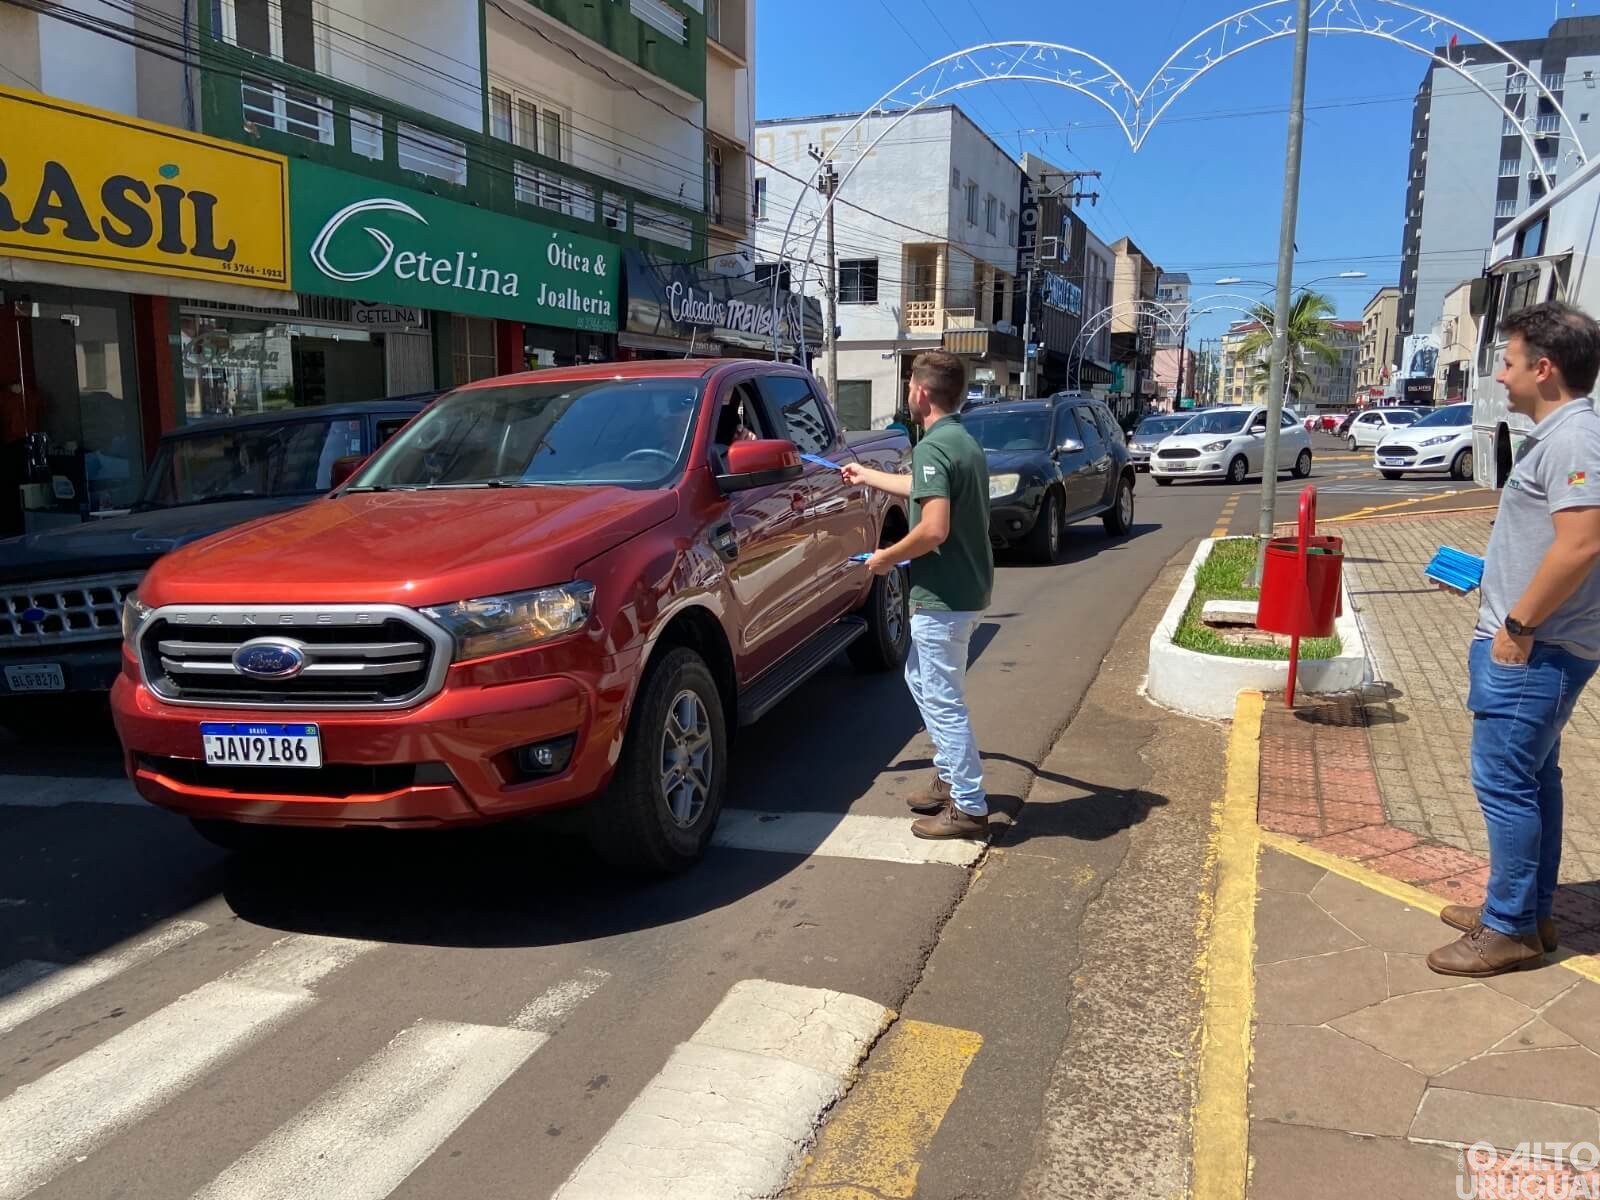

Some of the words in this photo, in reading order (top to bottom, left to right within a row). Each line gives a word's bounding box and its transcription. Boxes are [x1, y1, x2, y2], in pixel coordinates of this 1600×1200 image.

[0, 157, 236, 262] ASIL
[309, 197, 519, 297] Getelina
[547, 232, 590, 273] Ótica
[593, 254, 607, 276] &
[537, 283, 611, 316] Joalheria
[666, 281, 723, 325] Calçados
[356, 309, 416, 323] GETELINA
[175, 613, 371, 625] RANGER
[247, 651, 285, 669] Ford
[248, 727, 268, 735] BRASIL
[213, 736, 308, 762] JAV9I86
